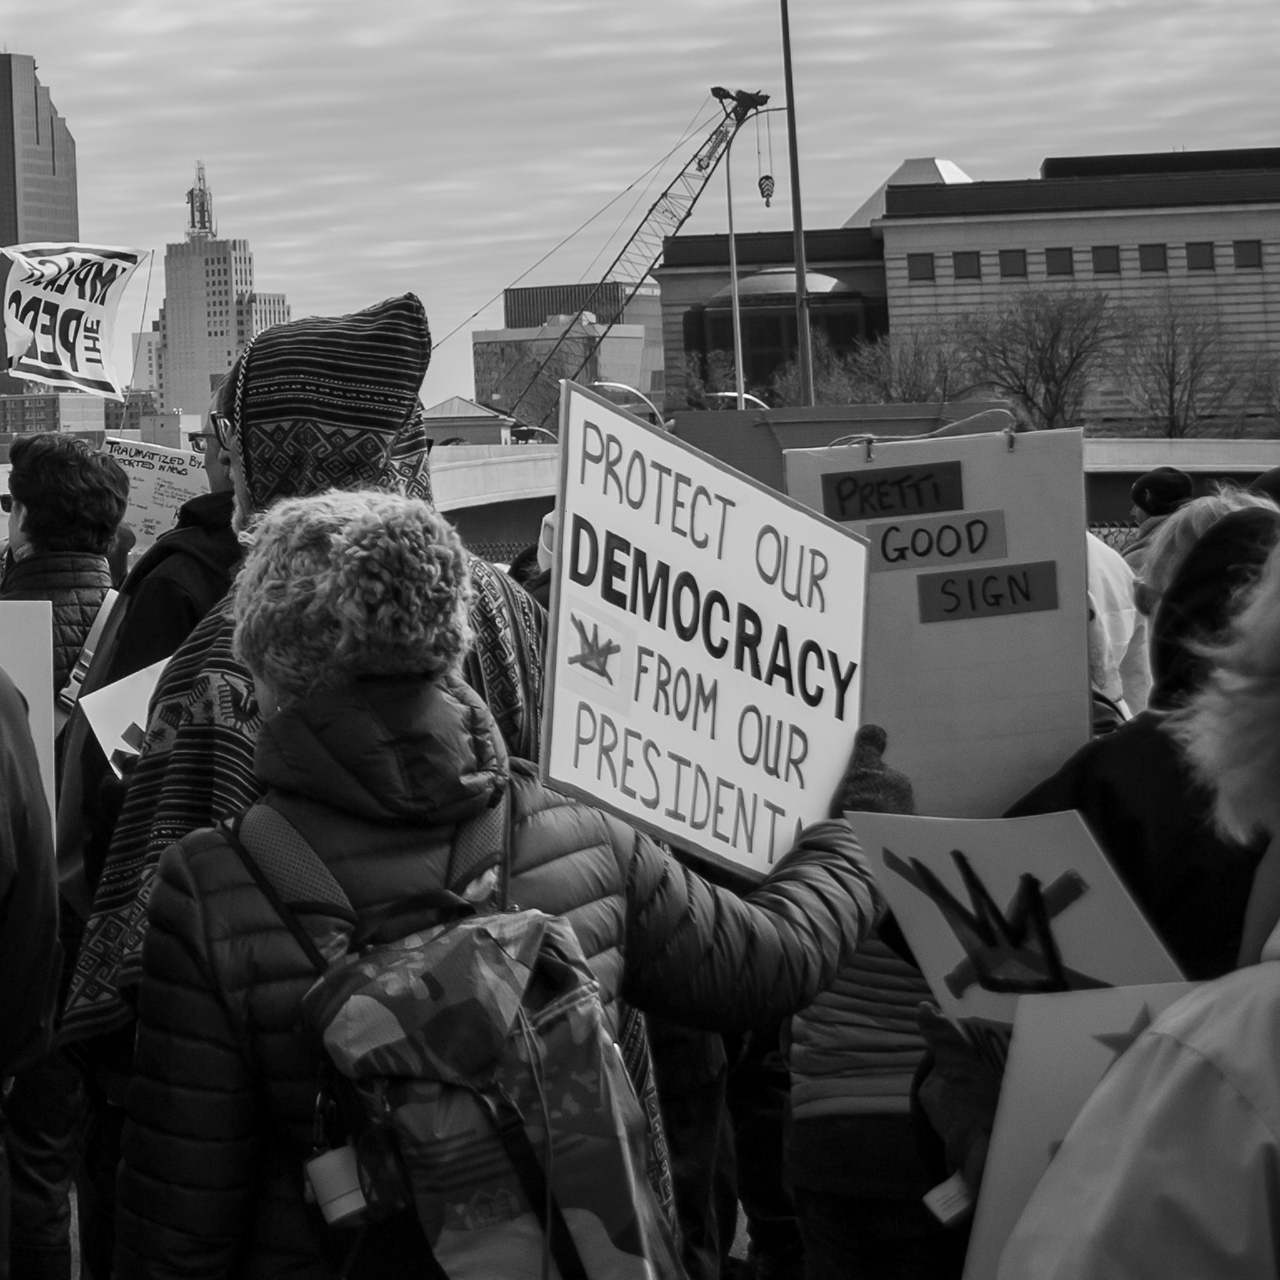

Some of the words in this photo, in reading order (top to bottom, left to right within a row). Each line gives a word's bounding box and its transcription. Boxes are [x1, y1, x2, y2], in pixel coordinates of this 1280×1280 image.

[106, 441, 185, 466] TRAUMATIZED
[580, 419, 736, 560] PROTECT
[755, 524, 828, 613] OUR
[881, 519, 988, 563] GOOD
[569, 512, 858, 722] DEMOCRACY
[941, 571, 1031, 613] SIGN
[634, 645, 718, 740] FROM
[738, 704, 808, 789] OUR
